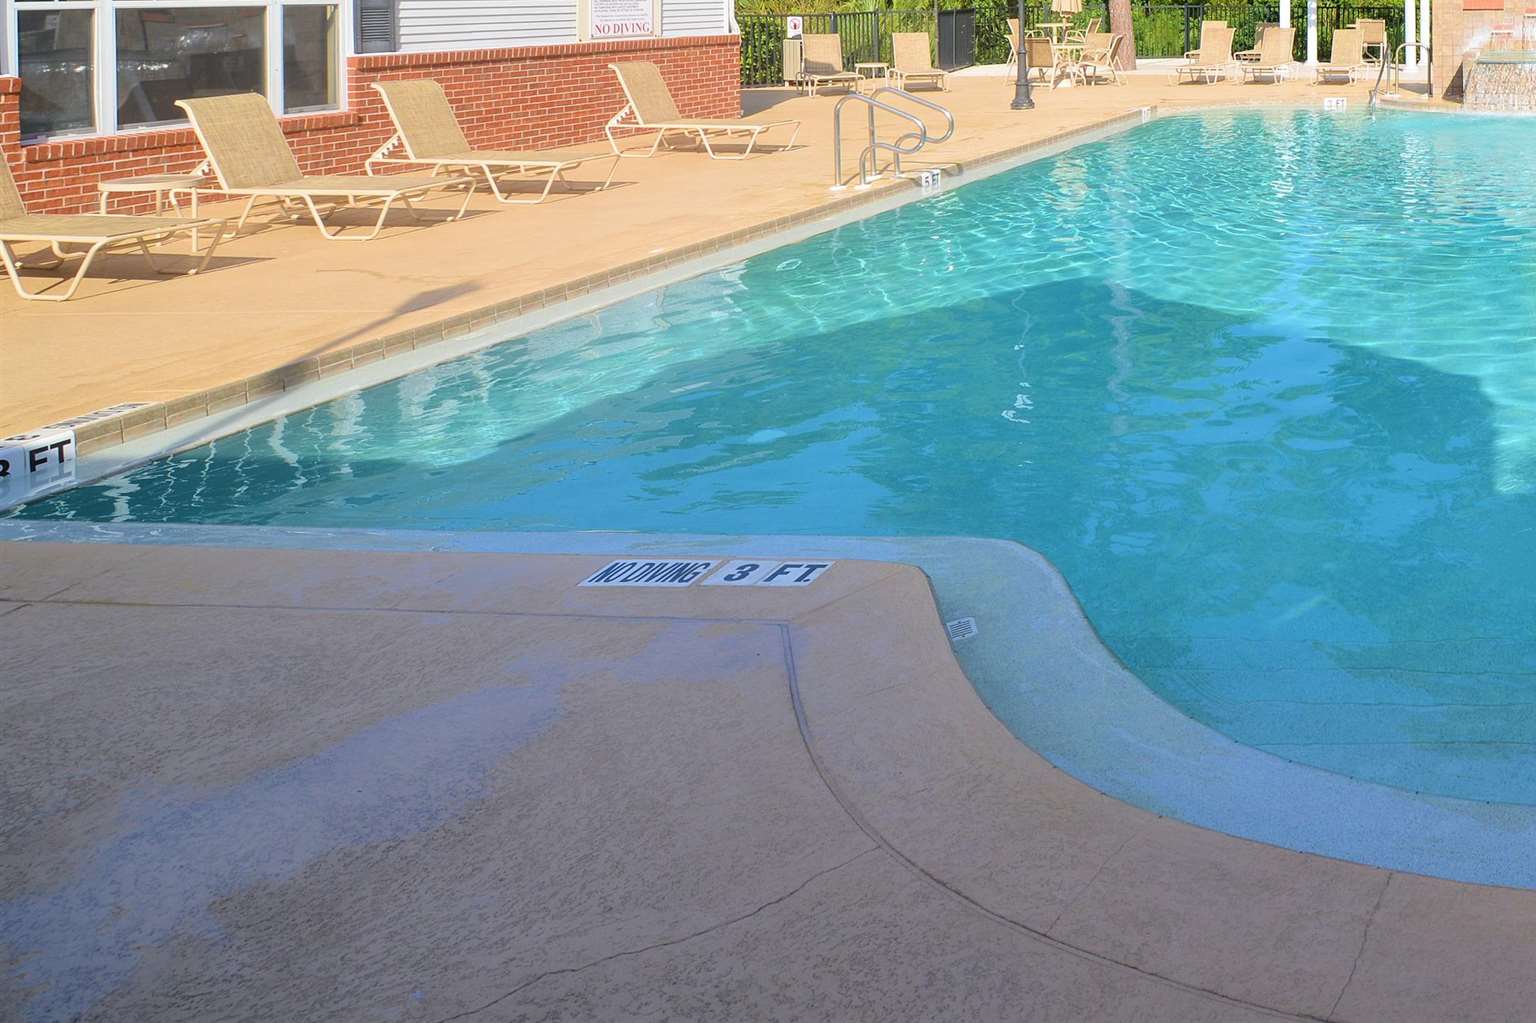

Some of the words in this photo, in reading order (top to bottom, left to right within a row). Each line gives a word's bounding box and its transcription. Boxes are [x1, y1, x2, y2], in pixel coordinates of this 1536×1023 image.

[594, 23, 610, 34] NO
[613, 22, 650, 34] DIVING
[28, 438, 72, 474] FT
[587, 561, 639, 583] NO
[618, 561, 711, 583] DIVING
[723, 563, 760, 583] 3
